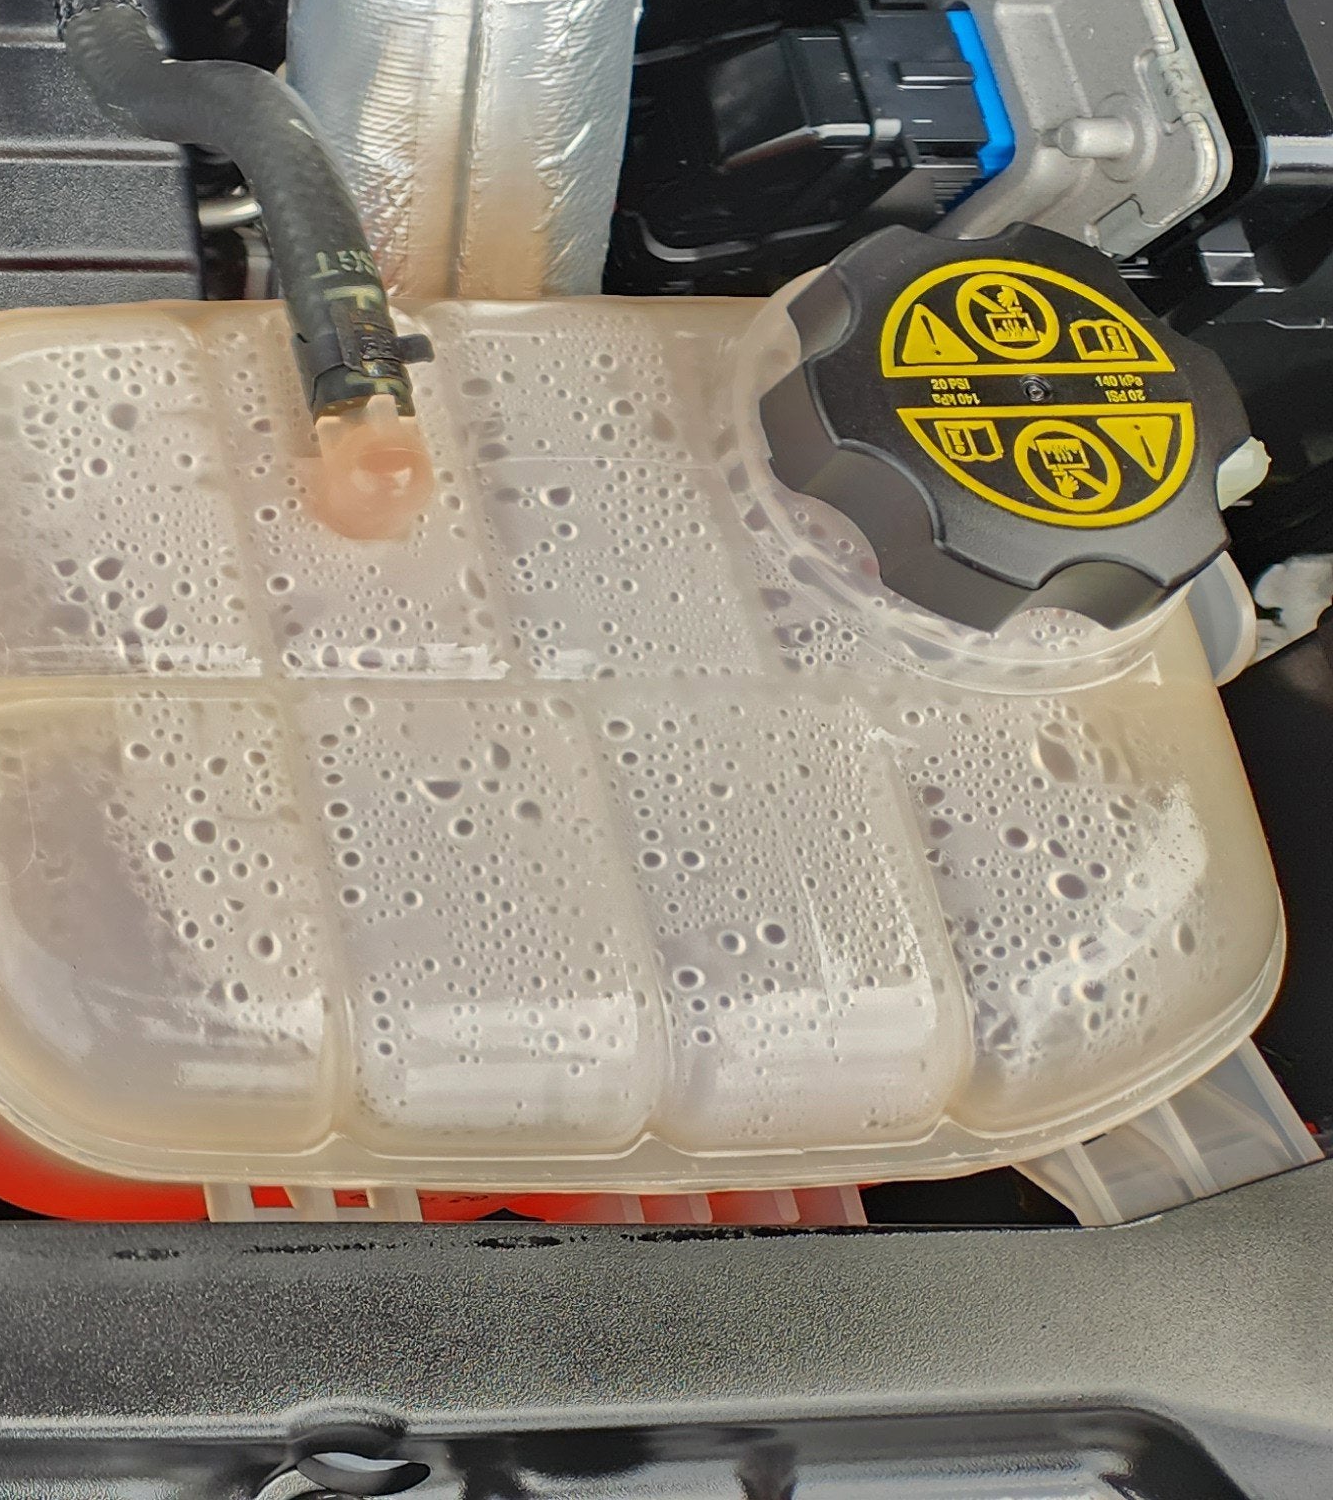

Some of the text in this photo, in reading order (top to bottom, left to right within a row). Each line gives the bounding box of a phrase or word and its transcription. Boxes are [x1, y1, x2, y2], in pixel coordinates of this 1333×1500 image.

[931, 378, 971, 390] 20 PSI
[1095, 375, 1117, 387] 140
